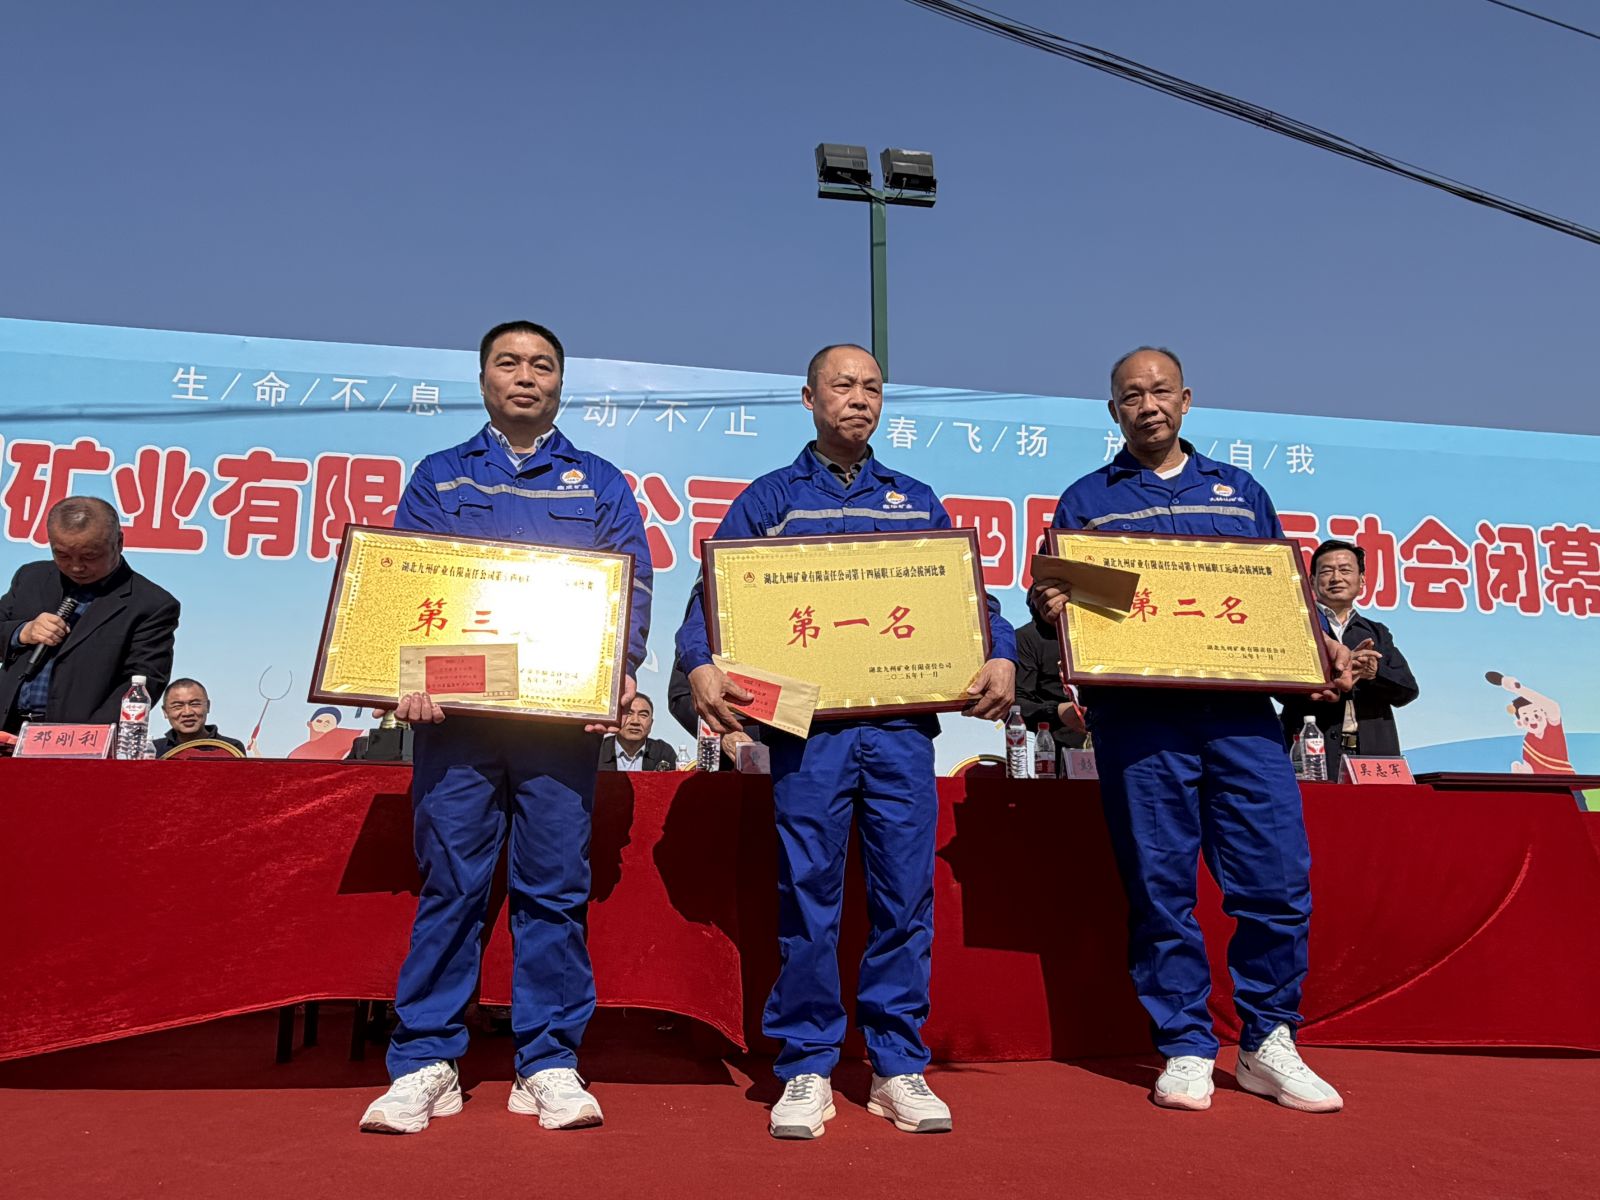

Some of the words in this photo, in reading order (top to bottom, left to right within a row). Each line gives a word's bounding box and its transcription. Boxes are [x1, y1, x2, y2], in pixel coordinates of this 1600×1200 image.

[408, 598, 498, 637] 第三
[1128, 588, 1249, 624] 第二名
[787, 605, 916, 648] 第一名
[33, 729, 99, 748] 邓刚利
[1360, 762, 1401, 778] 吴志军
